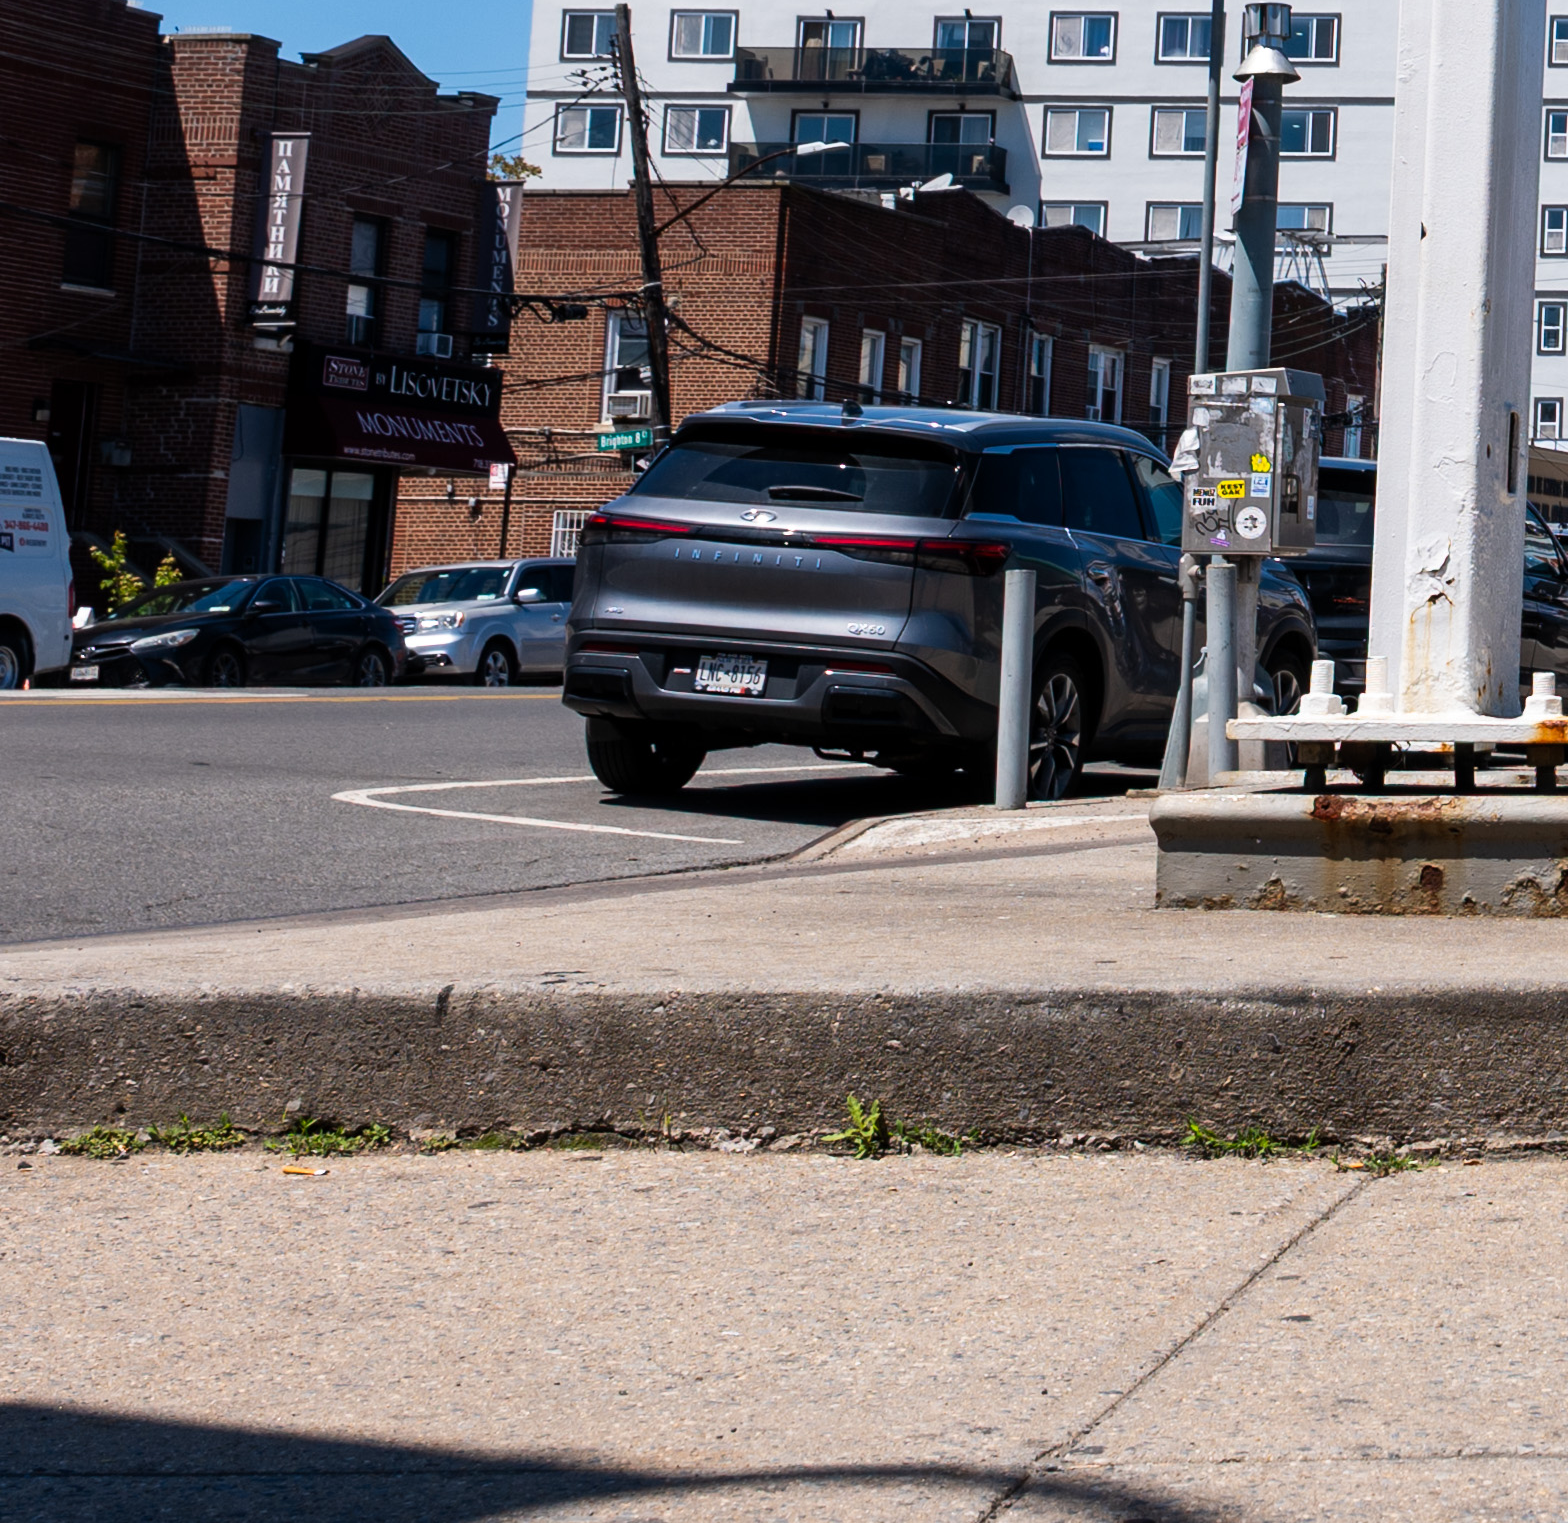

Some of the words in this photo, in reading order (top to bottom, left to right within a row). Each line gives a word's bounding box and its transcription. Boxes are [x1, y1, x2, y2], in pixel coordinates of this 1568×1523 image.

[390, 365, 492, 407] LISOVETSKY
[355, 411, 485, 447] MONUMENTS
[601, 434, 632, 449] Brighton
[674, 547, 822, 570] INFINITI
